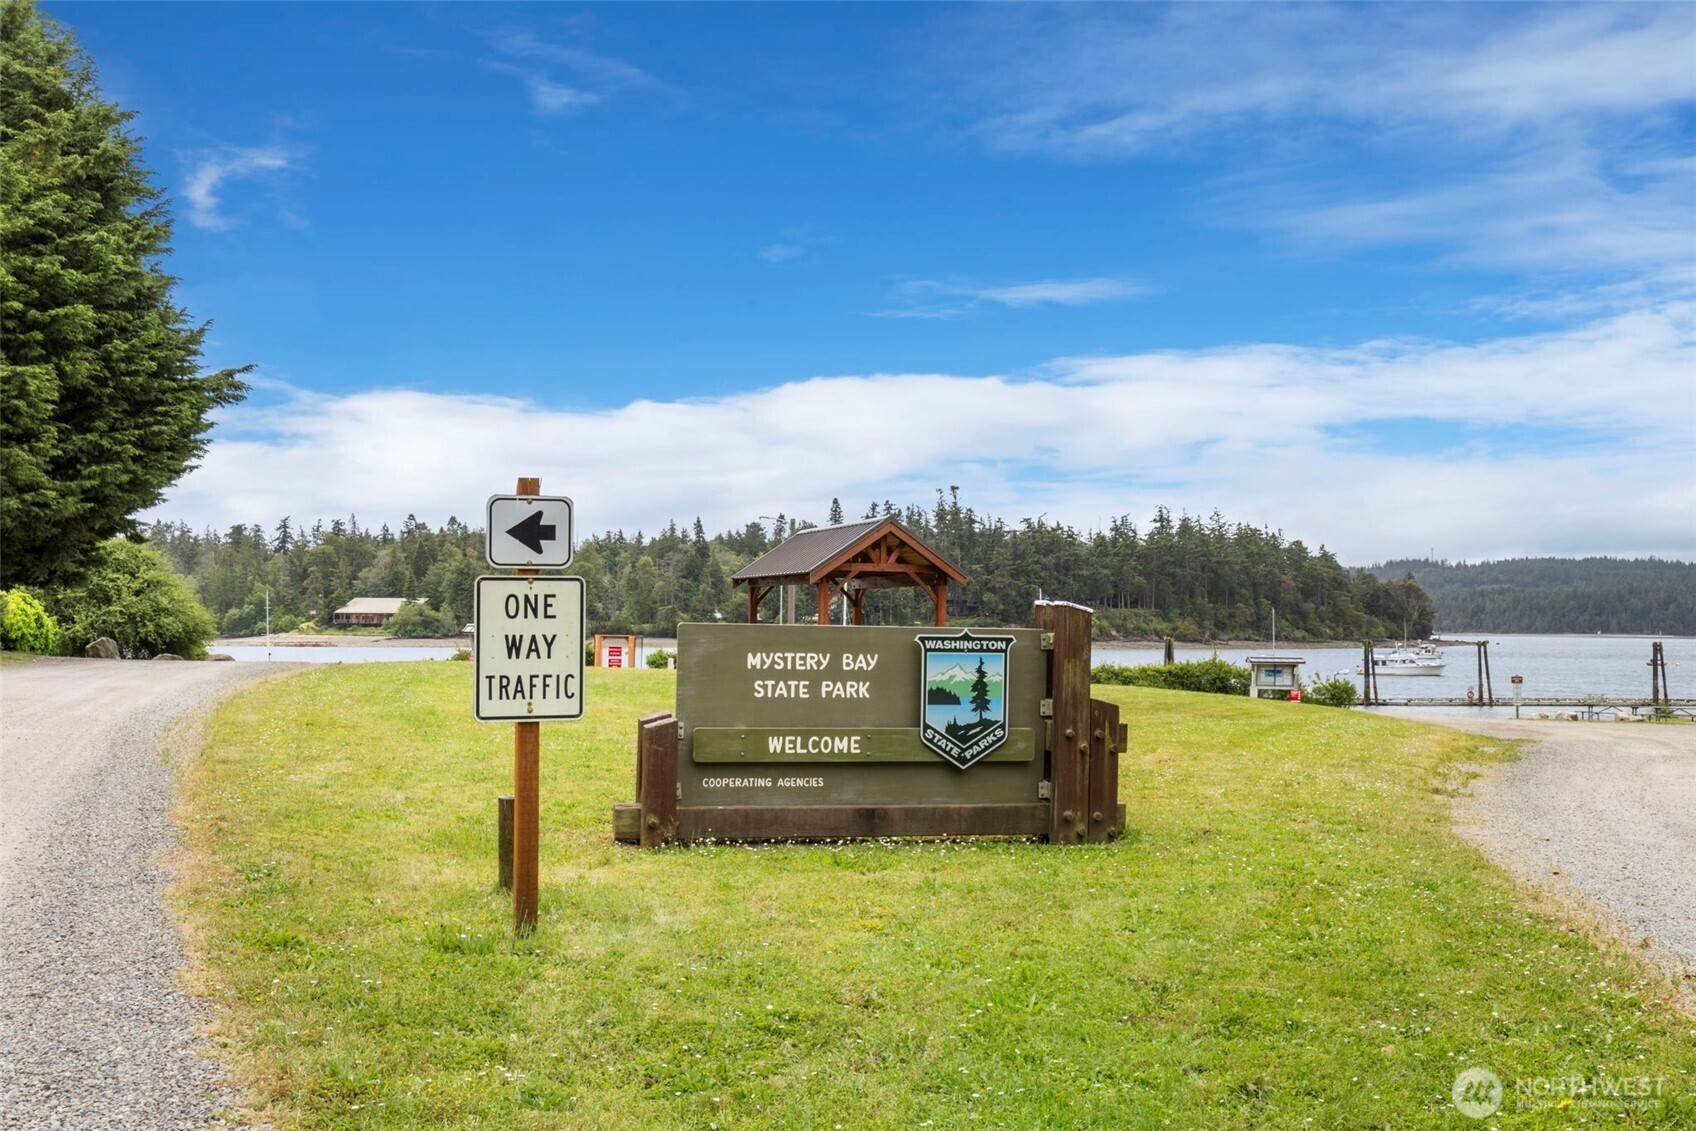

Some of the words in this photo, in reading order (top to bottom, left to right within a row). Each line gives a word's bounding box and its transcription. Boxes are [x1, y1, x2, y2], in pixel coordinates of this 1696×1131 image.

[504, 593, 557, 620] ONE
[504, 633, 558, 660] WAY
[924, 640, 1007, 650] WASHINGTON
[746, 652, 831, 670] MYSTERY
[842, 653, 879, 671] BAY
[485, 673, 576, 701] TRAFFIC
[753, 680, 810, 698] STATE
[821, 681, 871, 699] PARK
[768, 735, 862, 754] WELCOME
[924, 728, 962, 758] STATE
[964, 727, 1005, 760] PARKS
[702, 777, 773, 788] COOPERATING
[776, 777, 825, 788] AGENCIES
